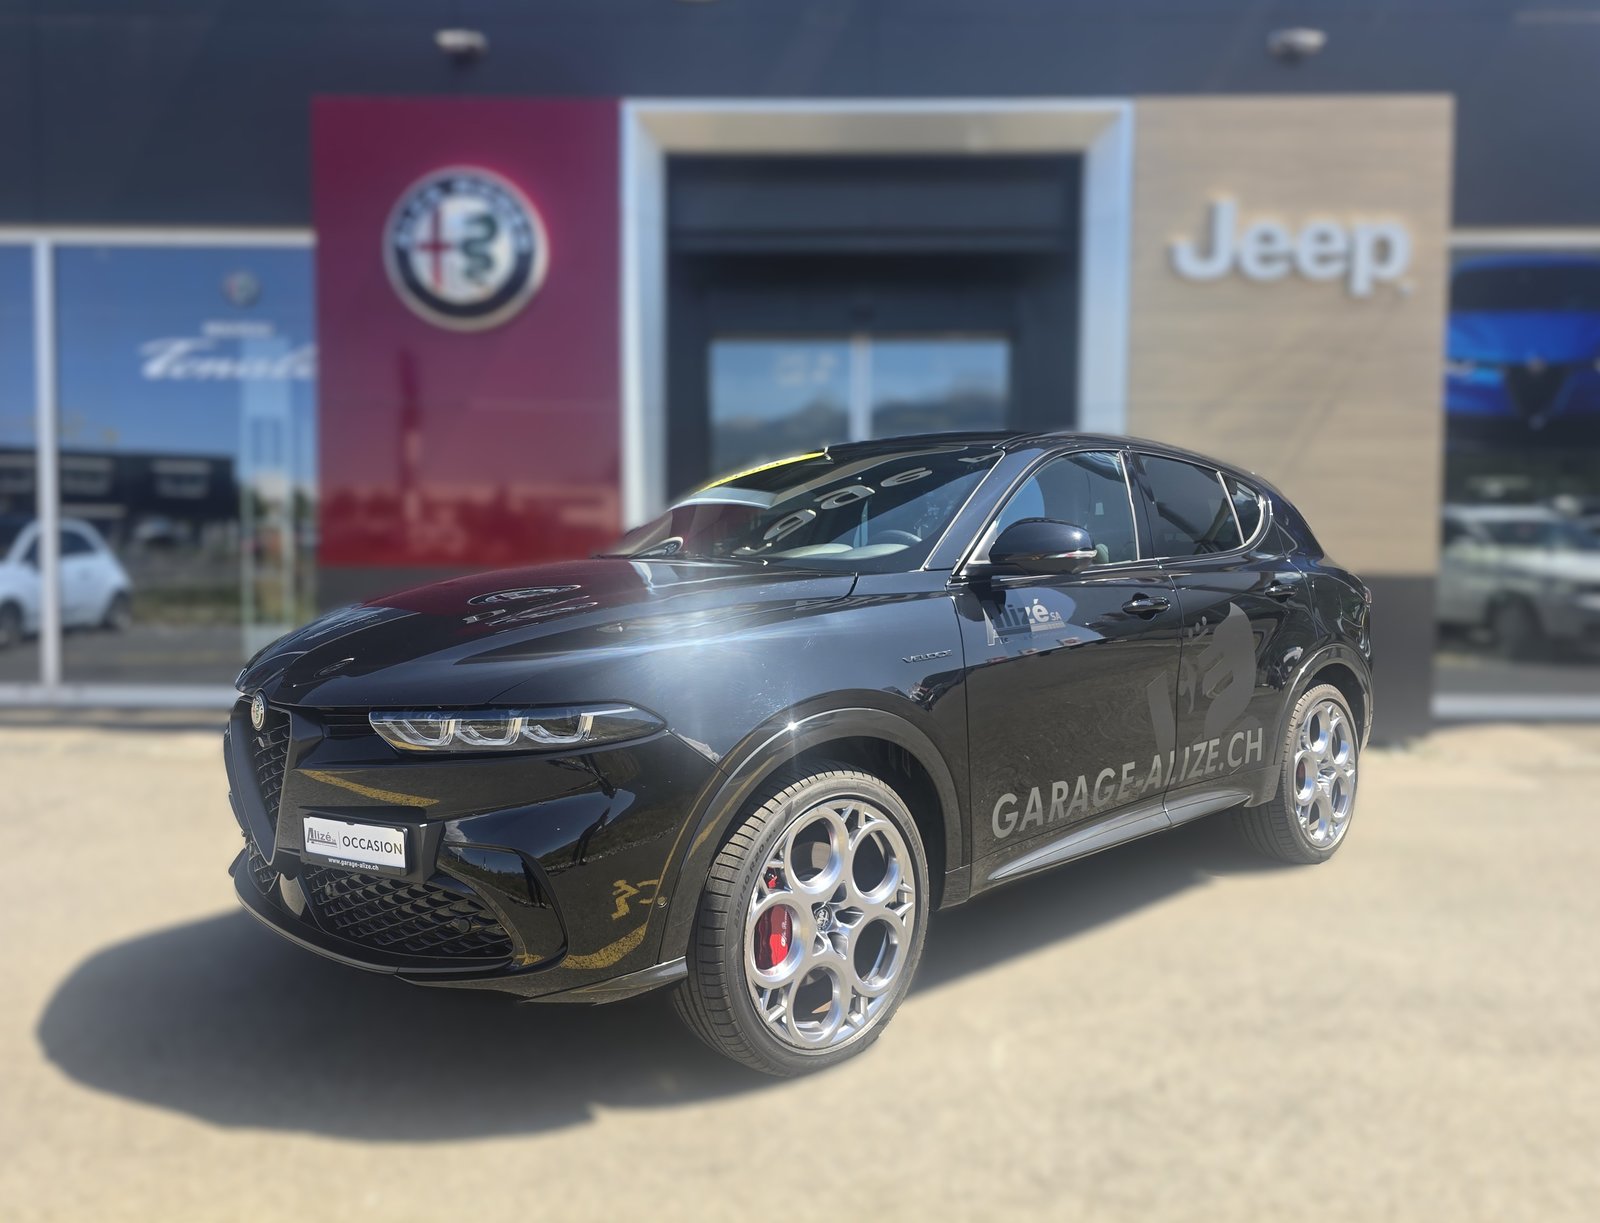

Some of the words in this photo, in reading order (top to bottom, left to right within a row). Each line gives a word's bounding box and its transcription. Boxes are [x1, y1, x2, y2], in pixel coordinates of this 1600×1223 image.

[1172, 198, 1411, 296] Jeep
[983, 599, 1050, 647] Alizé
[1050, 611, 1062, 622] SA
[902, 649, 952, 664] VELOCE
[991, 727, 1263, 839] GARAGE-ALIZE.CH
[307, 827, 332, 844] Alizé
[342, 835, 403, 855] OCCASION
[328, 858, 379, 871] www.garage-alize.ch
